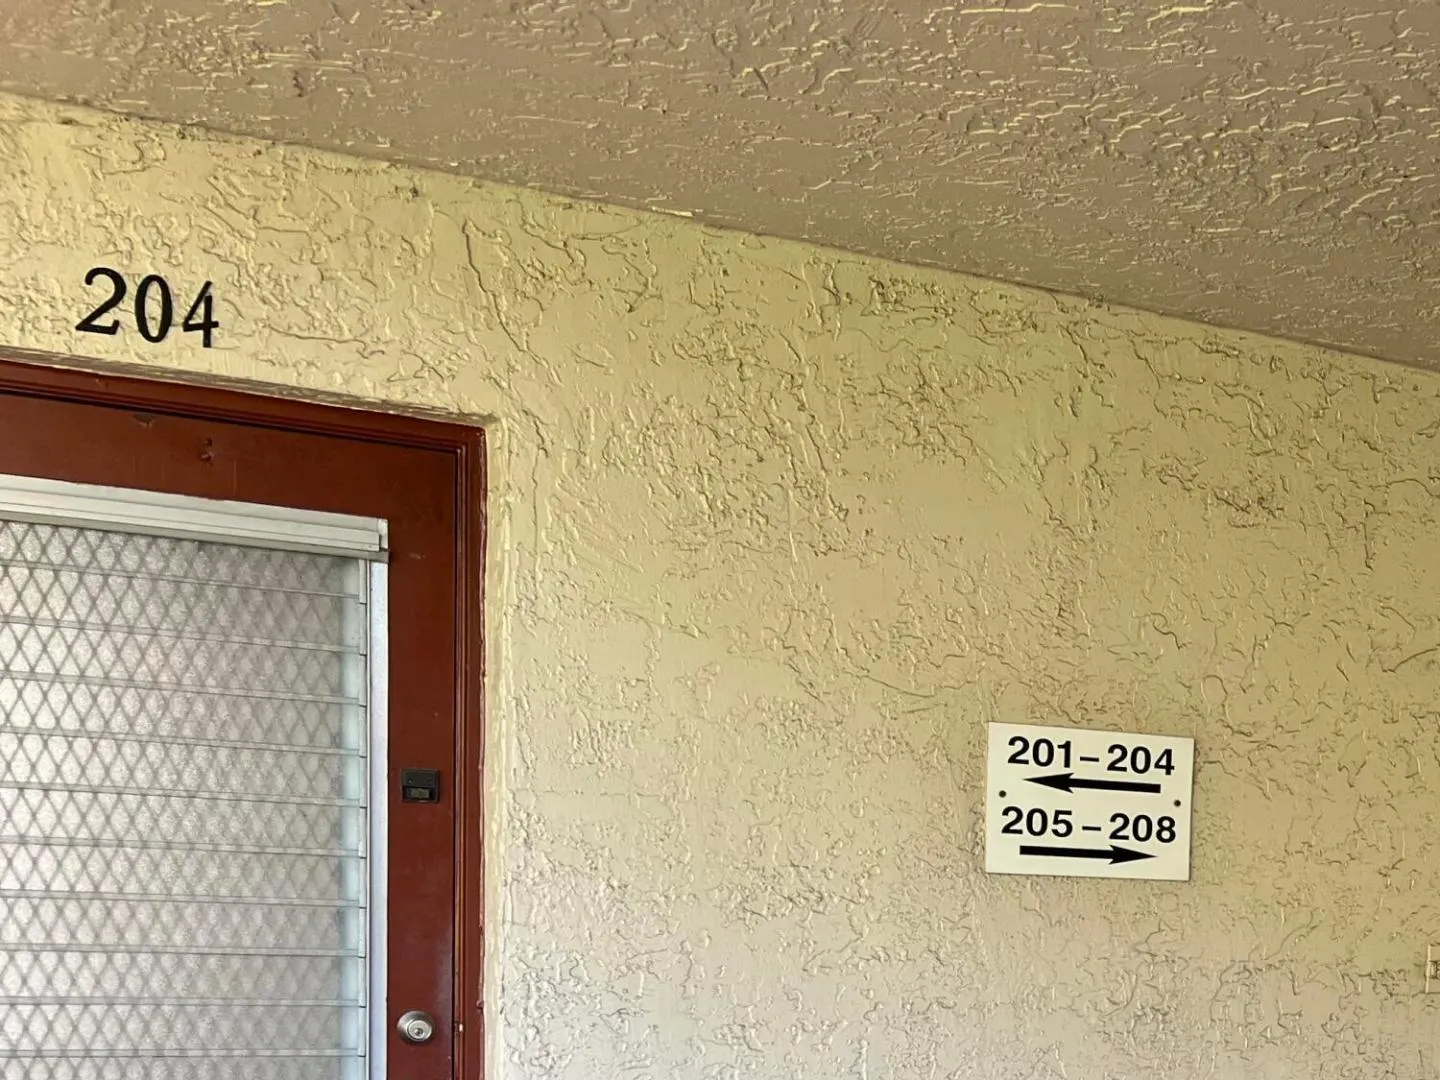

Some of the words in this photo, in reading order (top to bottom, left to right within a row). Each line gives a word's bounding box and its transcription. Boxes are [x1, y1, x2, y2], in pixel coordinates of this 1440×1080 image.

[75, 267, 219, 348] 204
[1007, 736, 1175, 776] 201-204
[1001, 806, 1176, 843] 205-208
